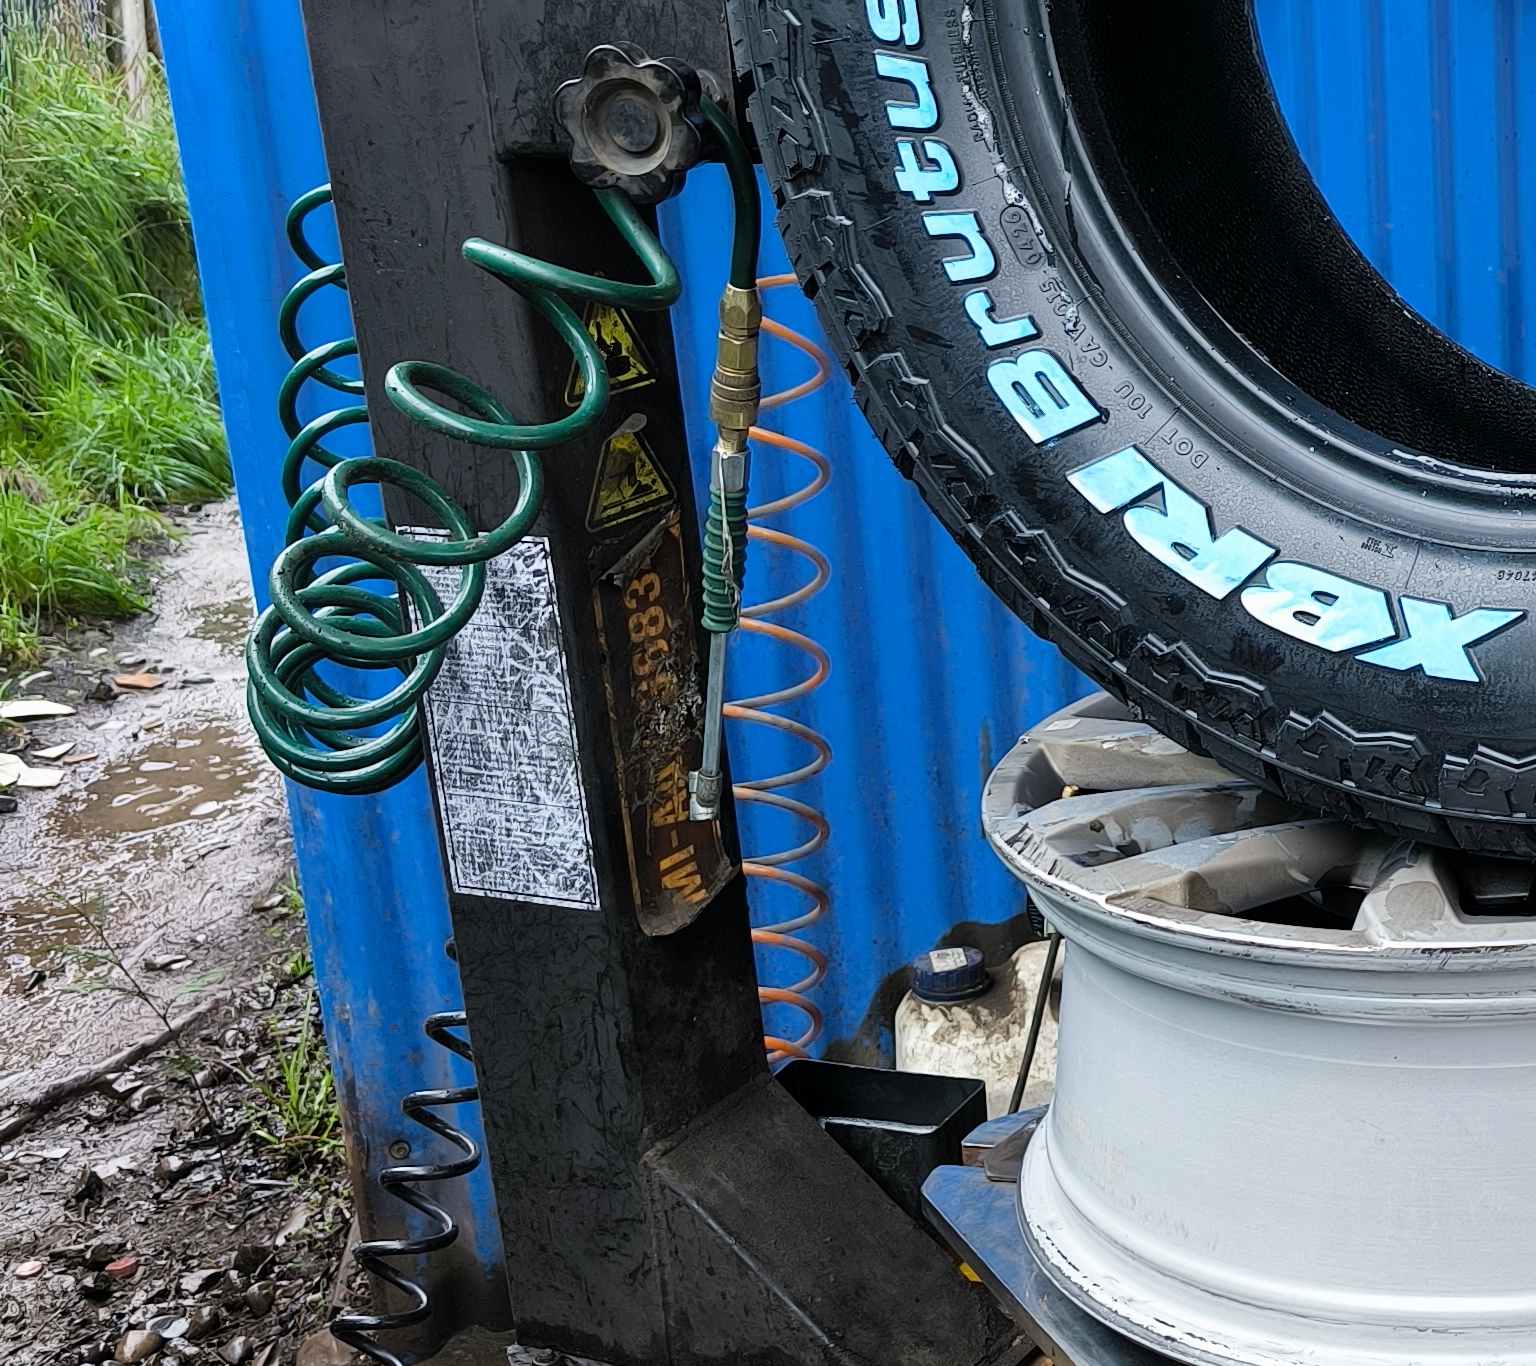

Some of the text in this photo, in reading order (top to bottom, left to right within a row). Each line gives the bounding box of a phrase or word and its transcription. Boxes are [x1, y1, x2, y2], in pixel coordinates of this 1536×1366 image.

[1003, 210, 1043, 267] 0426
[1160, 428, 1210, 469] DOT
[1066, 447, 1529, 685] XBRI
